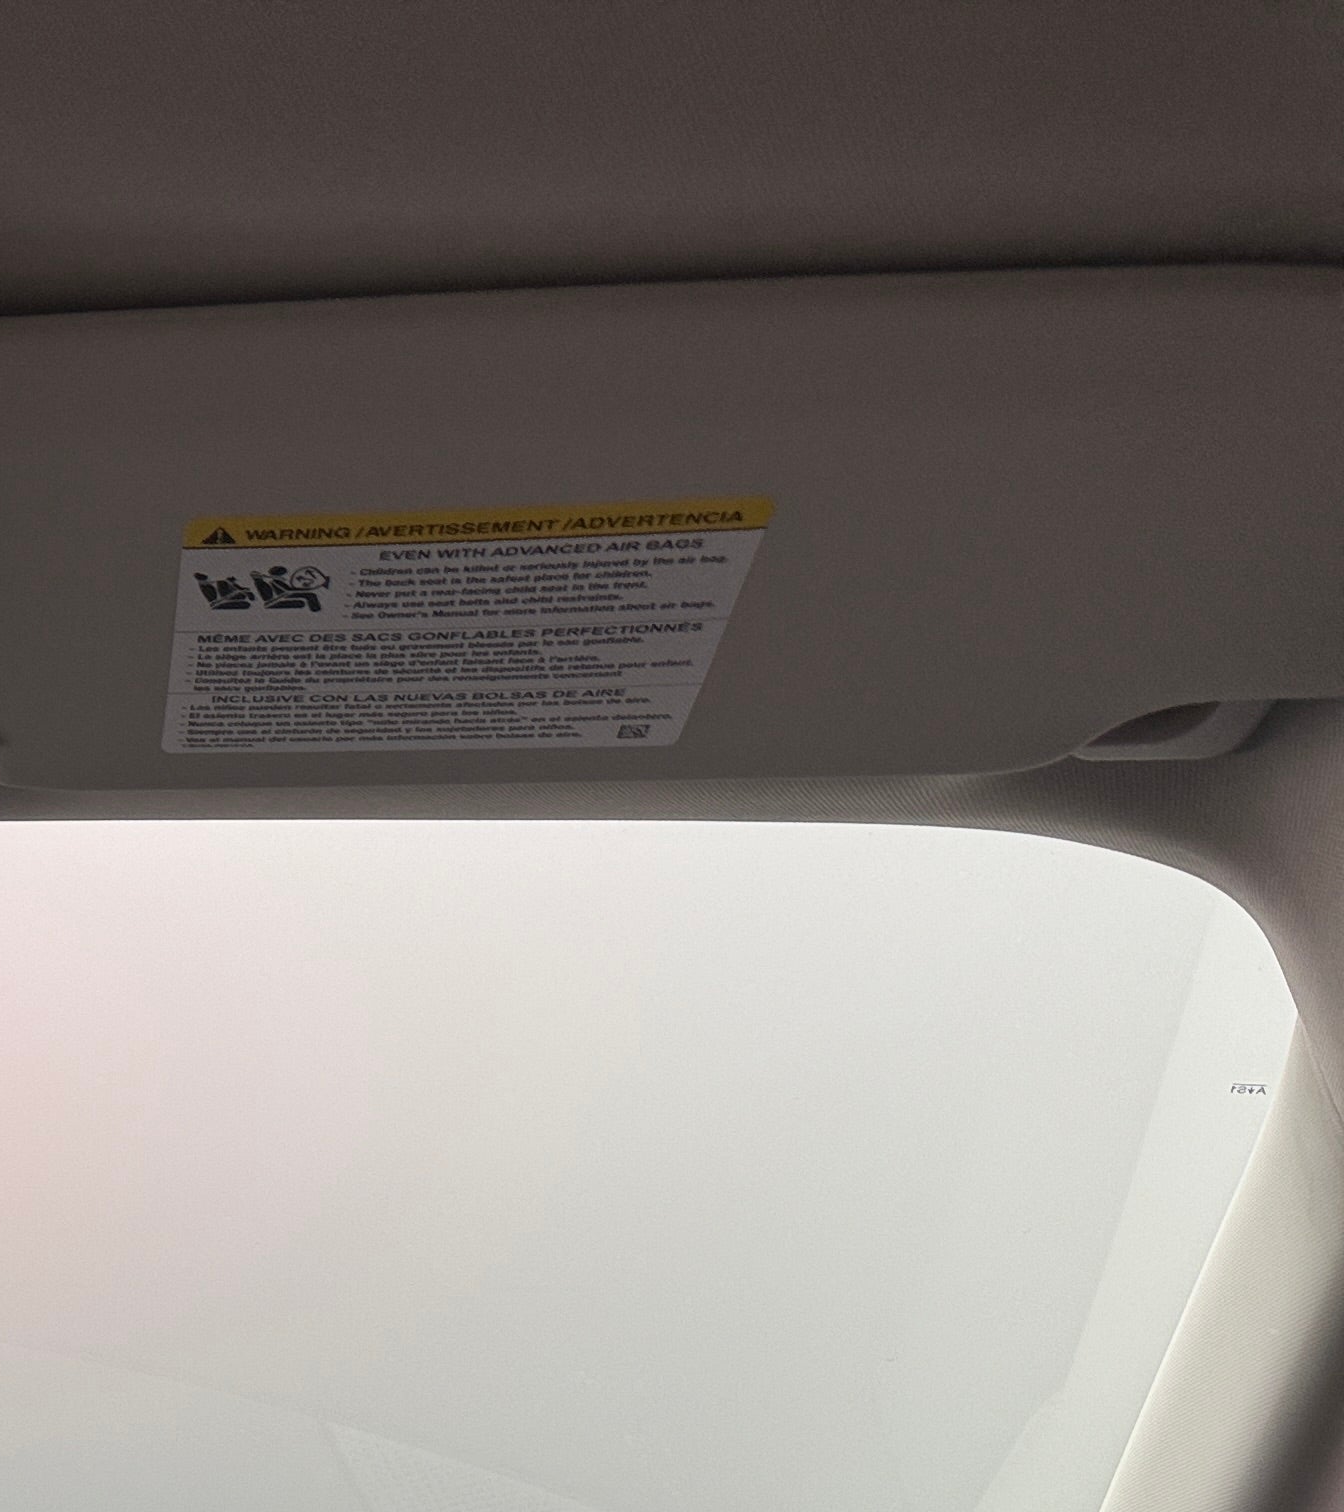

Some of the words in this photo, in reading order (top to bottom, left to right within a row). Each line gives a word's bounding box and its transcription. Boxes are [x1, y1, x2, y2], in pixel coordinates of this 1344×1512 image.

[245, 528, 350, 541] WARNING
[379, 549, 432, 561] EVEN
[437, 548, 486, 559] WITH
[490, 543, 602, 558] ADVANCED
[605, 541, 641, 552] AIR
[645, 539, 704, 551] BAGS
[255, 634, 304, 643] AVEC
[308, 633, 346, 643] DES
[351, 633, 402, 642] SACS
[409, 629, 536, 641] GONFLABLES
[211, 695, 305, 703] INCLUSIVE
[309, 694, 349, 703] CON
[353, 693, 390, 702] LAS
[394, 692, 466, 702] NUEVAS
[472, 691, 547, 700] BOLSAS
[551, 690, 579, 698] DE
[581, 688, 628, 697] AIRE
